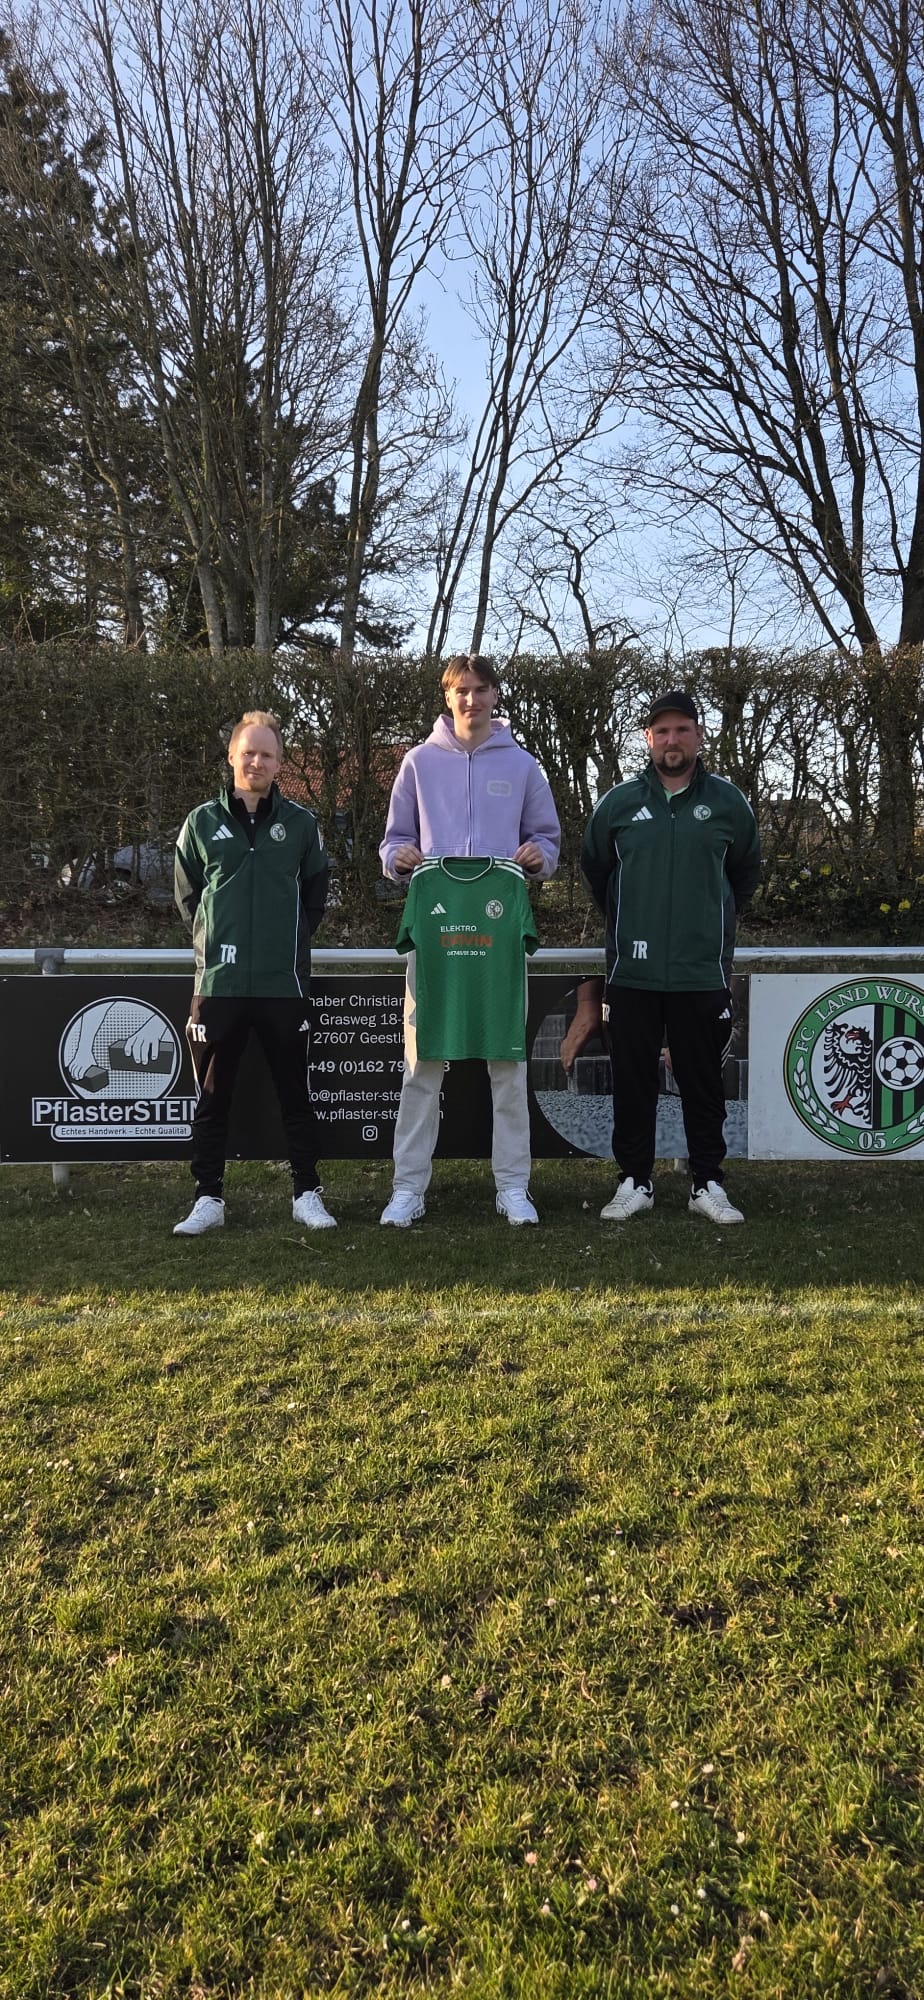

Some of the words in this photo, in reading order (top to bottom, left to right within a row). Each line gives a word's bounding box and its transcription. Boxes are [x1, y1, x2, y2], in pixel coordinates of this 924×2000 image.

[220, 944, 236, 964] TR
[632, 941, 648, 960] TR
[319, 1013, 377, 1028] Grasweg
[380, 1013, 405, 1026] 18-
[795, 1027, 815, 1054] FC
[815, 986, 870, 1022] LAND
[190, 1023, 207, 1043] TR
[313, 1032, 356, 1044] 27607
[308, 1060, 336, 1073] +49
[339, 1060, 384, 1075] (0)162
[60, 1127, 87, 1136] Echtes
[88, 1127, 127, 1136] Handwerk
[135, 1126, 156, 1135] Echte
[158, 1126, 187, 1136] Qualität
[857, 1131, 887, 1151] 05
